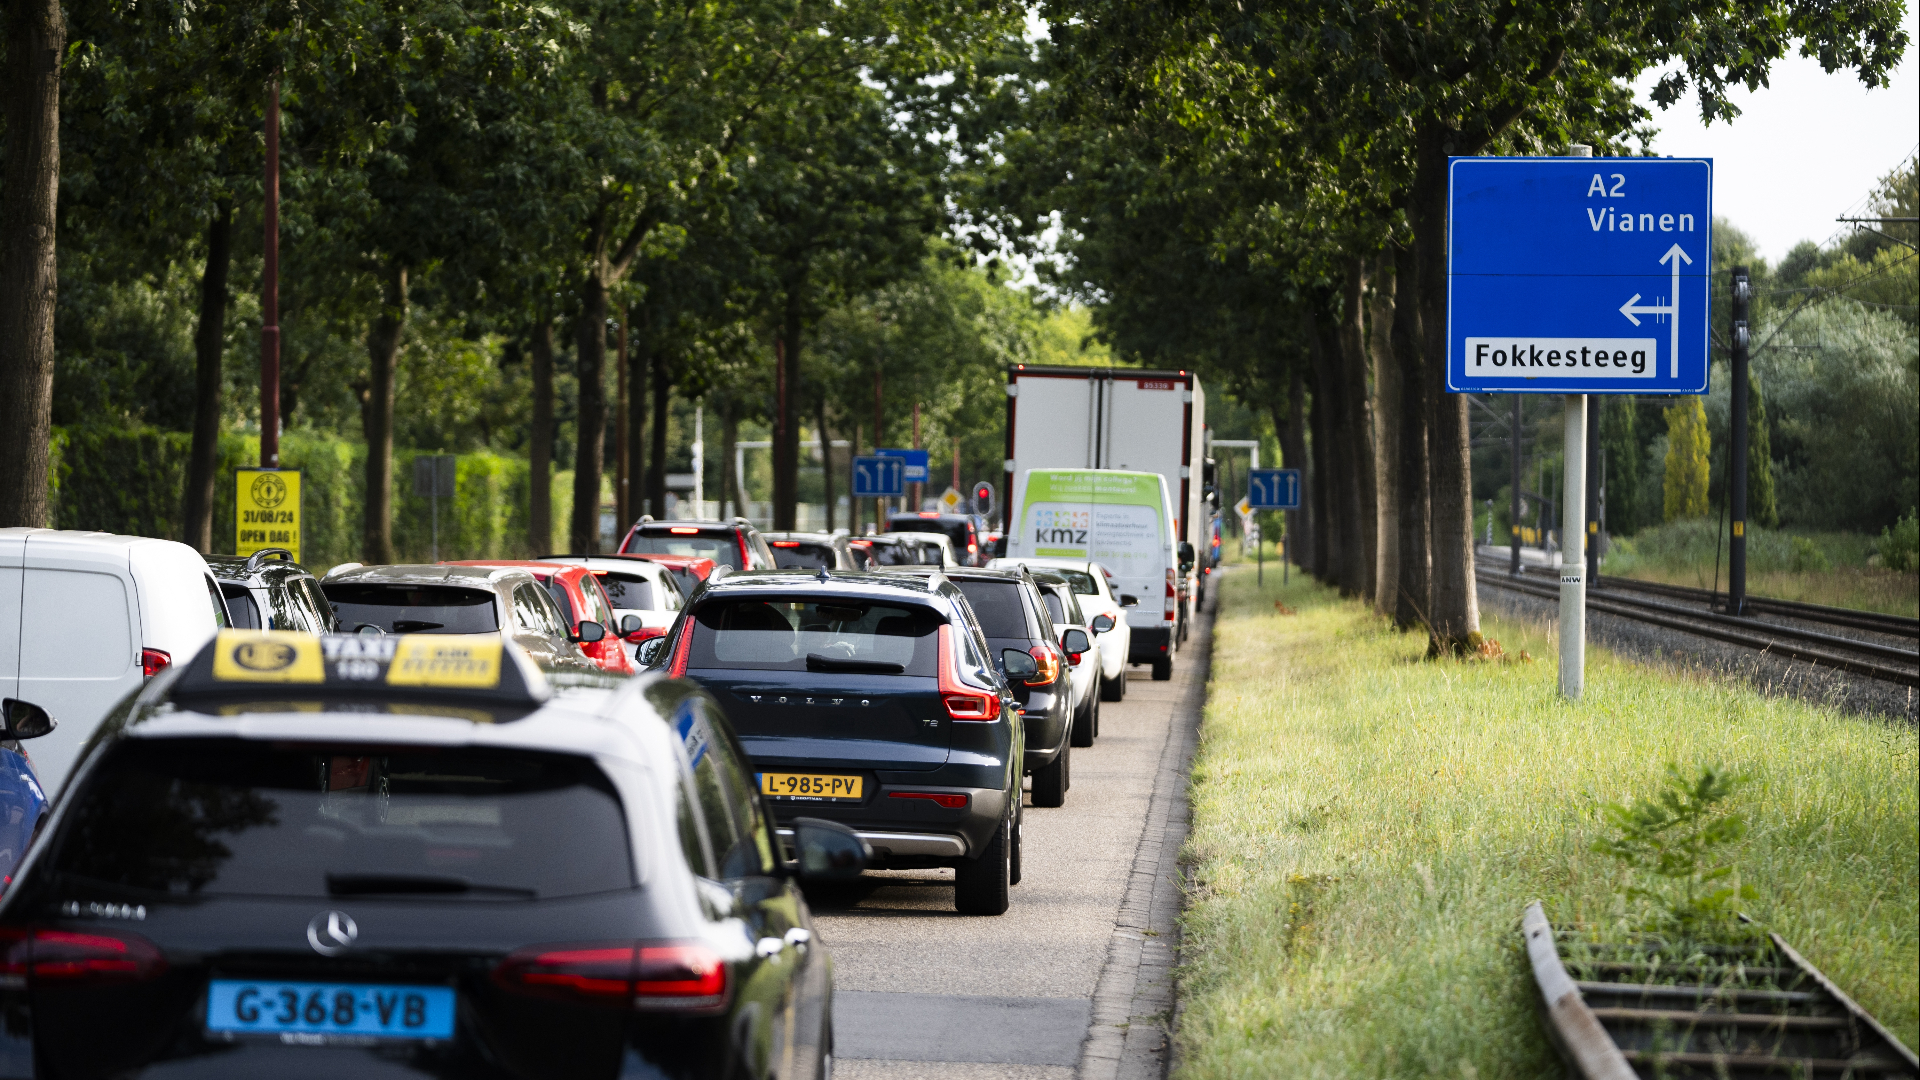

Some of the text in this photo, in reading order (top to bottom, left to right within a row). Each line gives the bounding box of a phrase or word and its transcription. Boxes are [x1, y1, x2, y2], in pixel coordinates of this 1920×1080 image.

[1587, 173, 1626, 198] A2
[1587, 207, 1694, 232] Vianen
[1475, 344, 1646, 374] Fokkesteeg
[243, 510, 294, 523] 31/08/24
[240, 529, 266, 542] OPEN
[269, 530, 290, 543] DAG
[323, 637, 397, 660] TAXI
[750, 695, 870, 707] VOLVO
[922, 719, 939, 727] T2
[769, 776, 855, 795] L-985-PV
[235, 987, 426, 1028] G-368-VB
